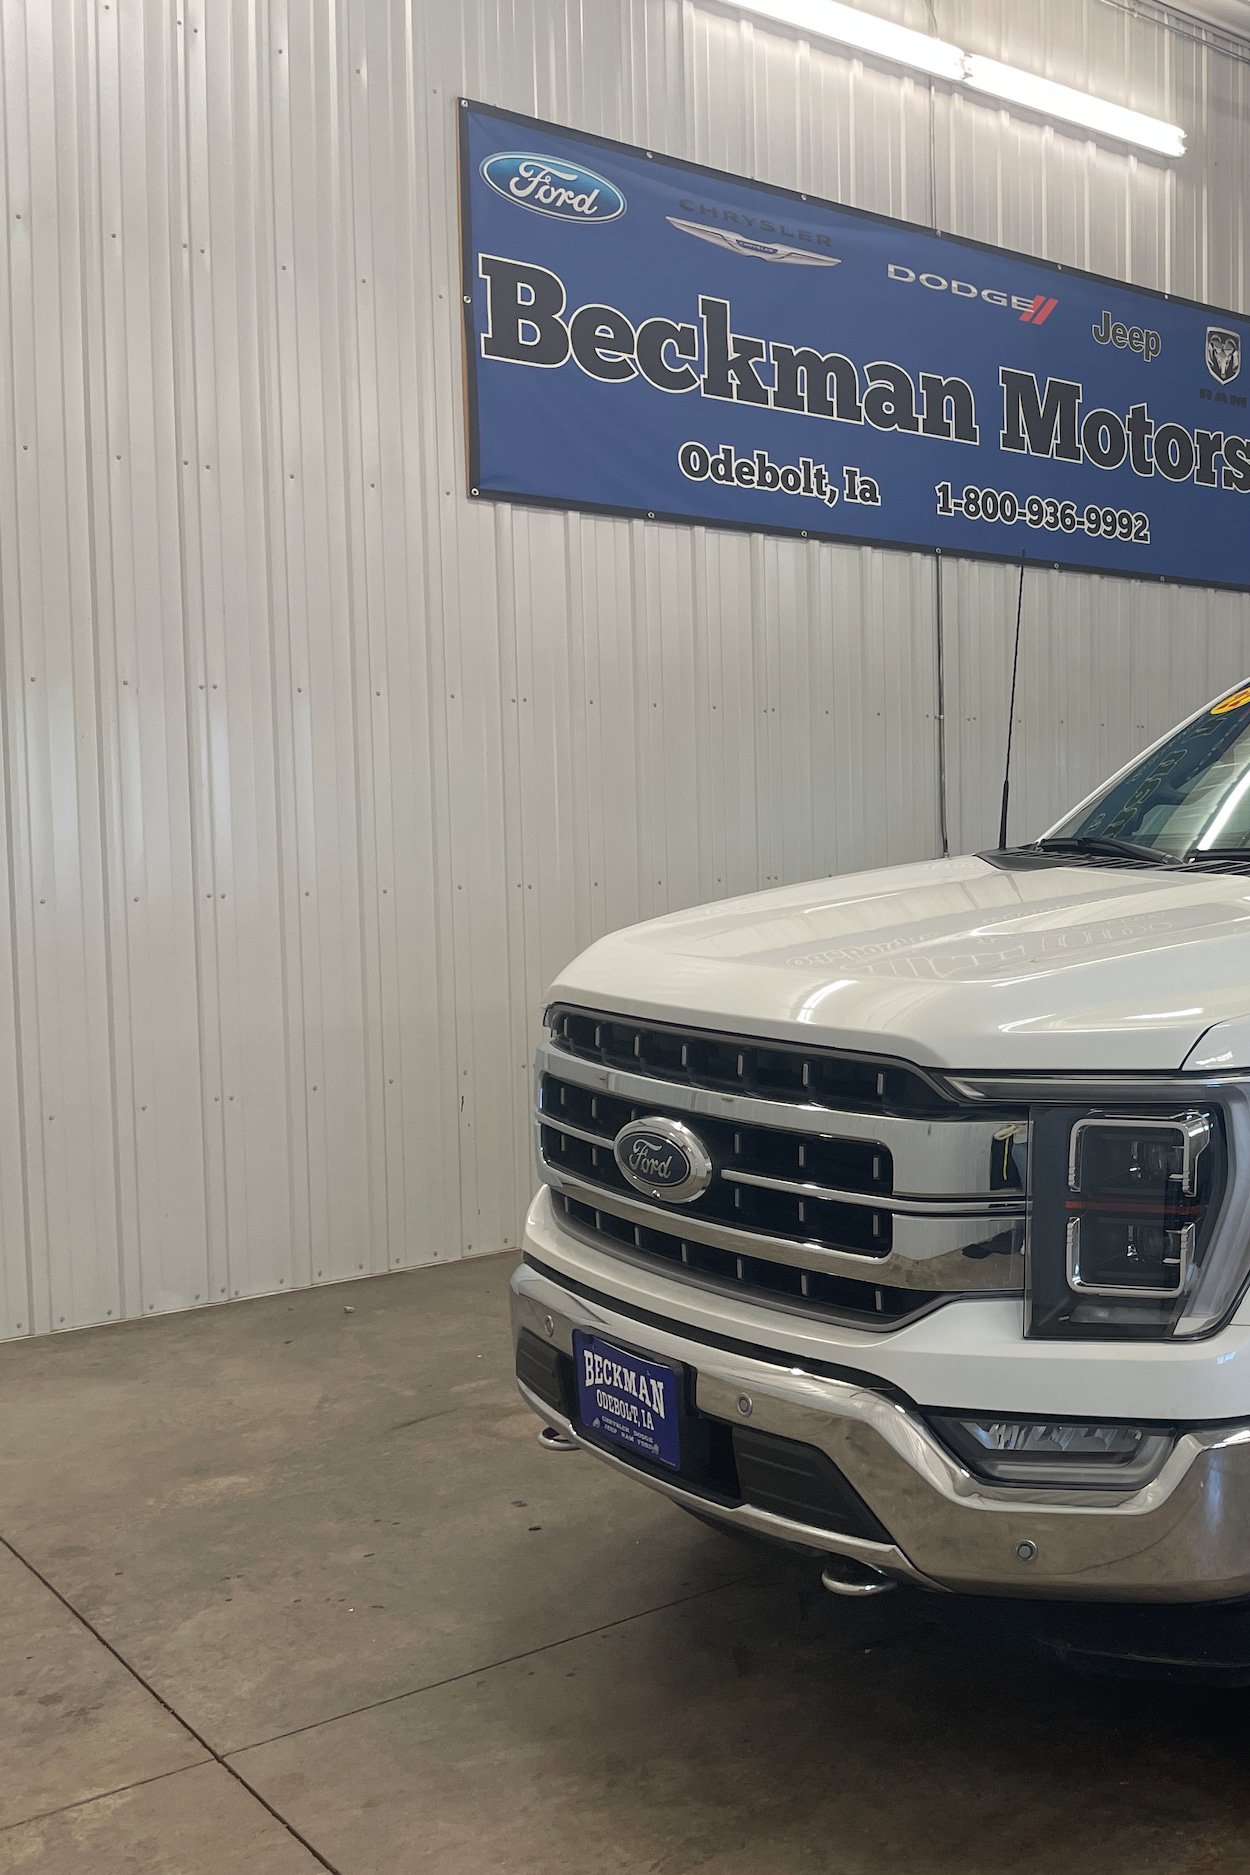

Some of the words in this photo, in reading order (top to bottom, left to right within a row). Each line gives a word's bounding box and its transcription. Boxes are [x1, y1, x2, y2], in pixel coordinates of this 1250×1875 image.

[509, 161, 600, 215] Ford
[679, 199, 833, 247] CHRYSLER
[887, 263, 1036, 313] DODGE
[478, 252, 979, 445] Beckman
[1092, 310, 1161, 361] Jeep
[1199, 388, 1247, 408] RAM
[678, 441, 839, 508] Odebolt,
[843, 465, 881, 506] Ia
[934, 481, 1150, 544] 1-800-936-9992
[628, 1139, 673, 1178] Ford
[583, 1350, 665, 1419] BECKMAN
[596, 1389, 641, 1427] ODEBOLT,
[641, 1409, 655, 1430] IA
